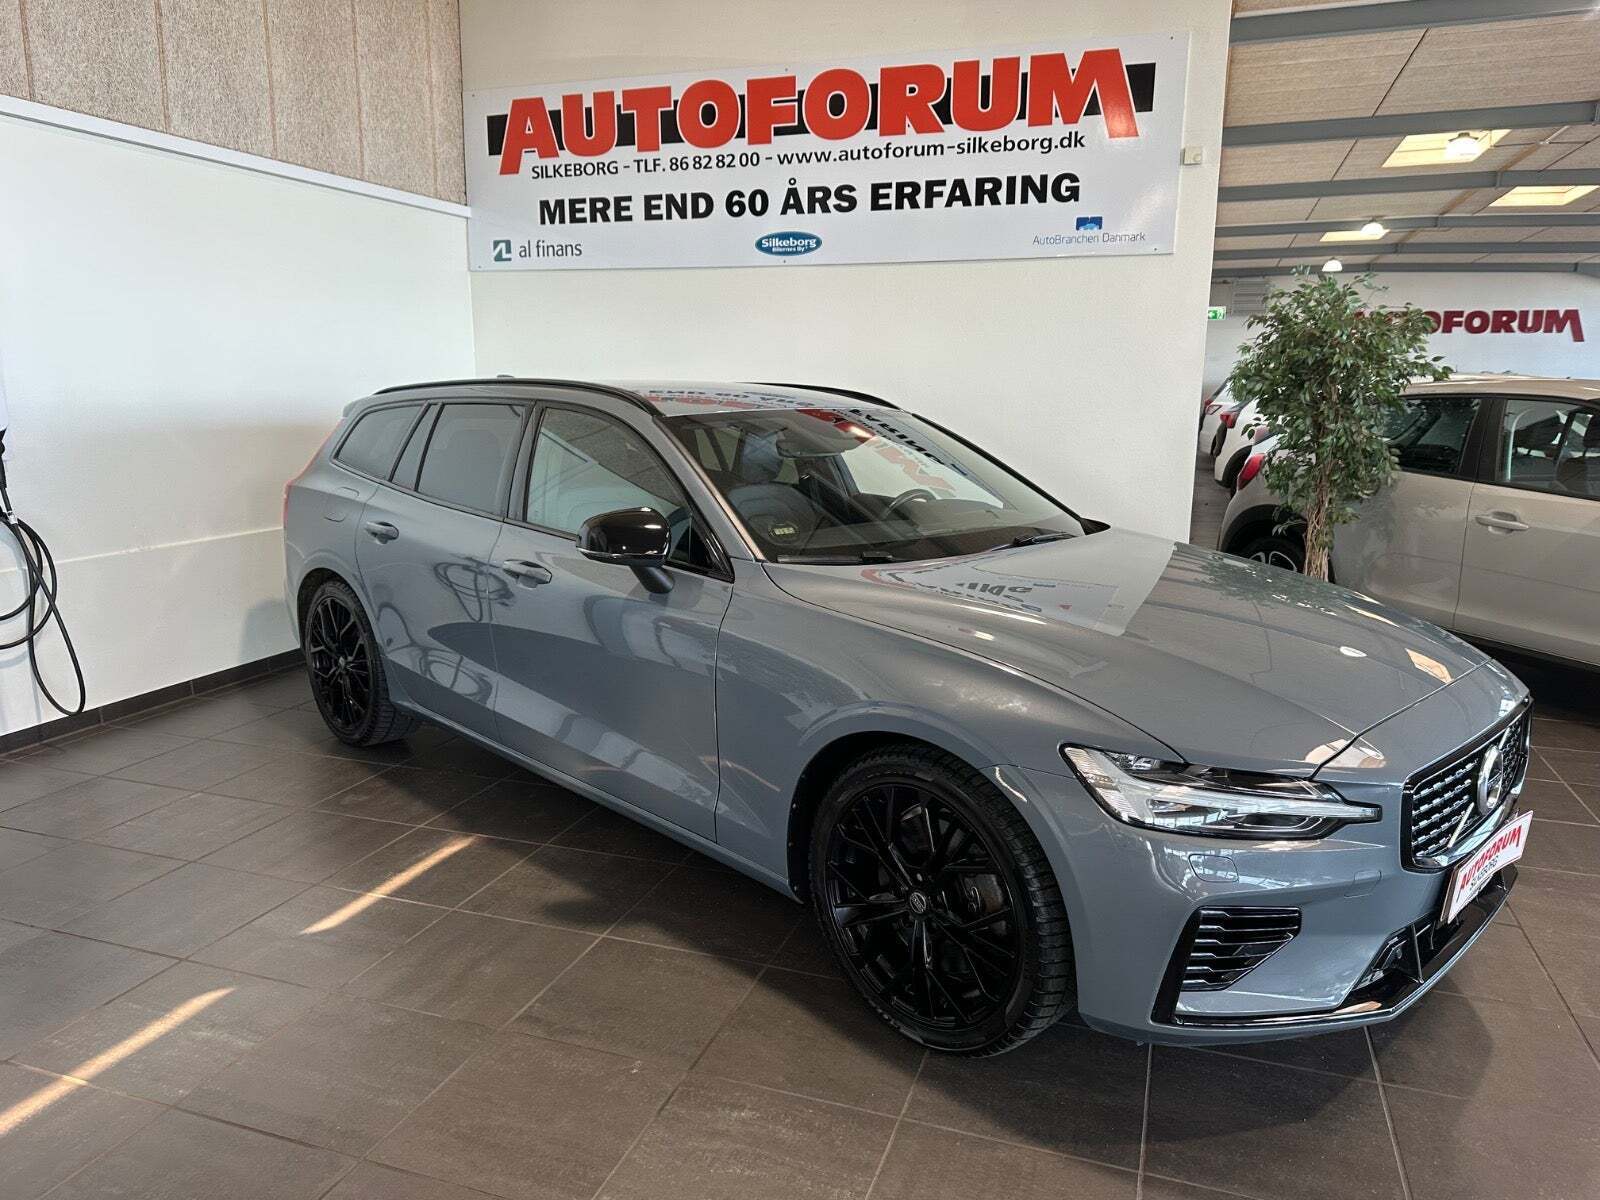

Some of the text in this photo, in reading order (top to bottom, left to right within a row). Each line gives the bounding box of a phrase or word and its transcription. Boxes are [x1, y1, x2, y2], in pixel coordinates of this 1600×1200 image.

[499, 48, 1139, 175] AUTOFORUM
[532, 160, 618, 179] SILKEBORG
[633, 158, 666, 173] TLF.
[778, 131, 1085, 166] www.autoforum-silkeborg.dk
[539, 172, 1081, 225] MERE END 60 ÅRS ERFARING
[518, 240, 583, 258] al finans
[761, 237, 817, 248] Silkeborg
[1033, 232, 1146, 246] AutoBranchen Danmark
[1460, 825, 1523, 891] AUTOFORUM
